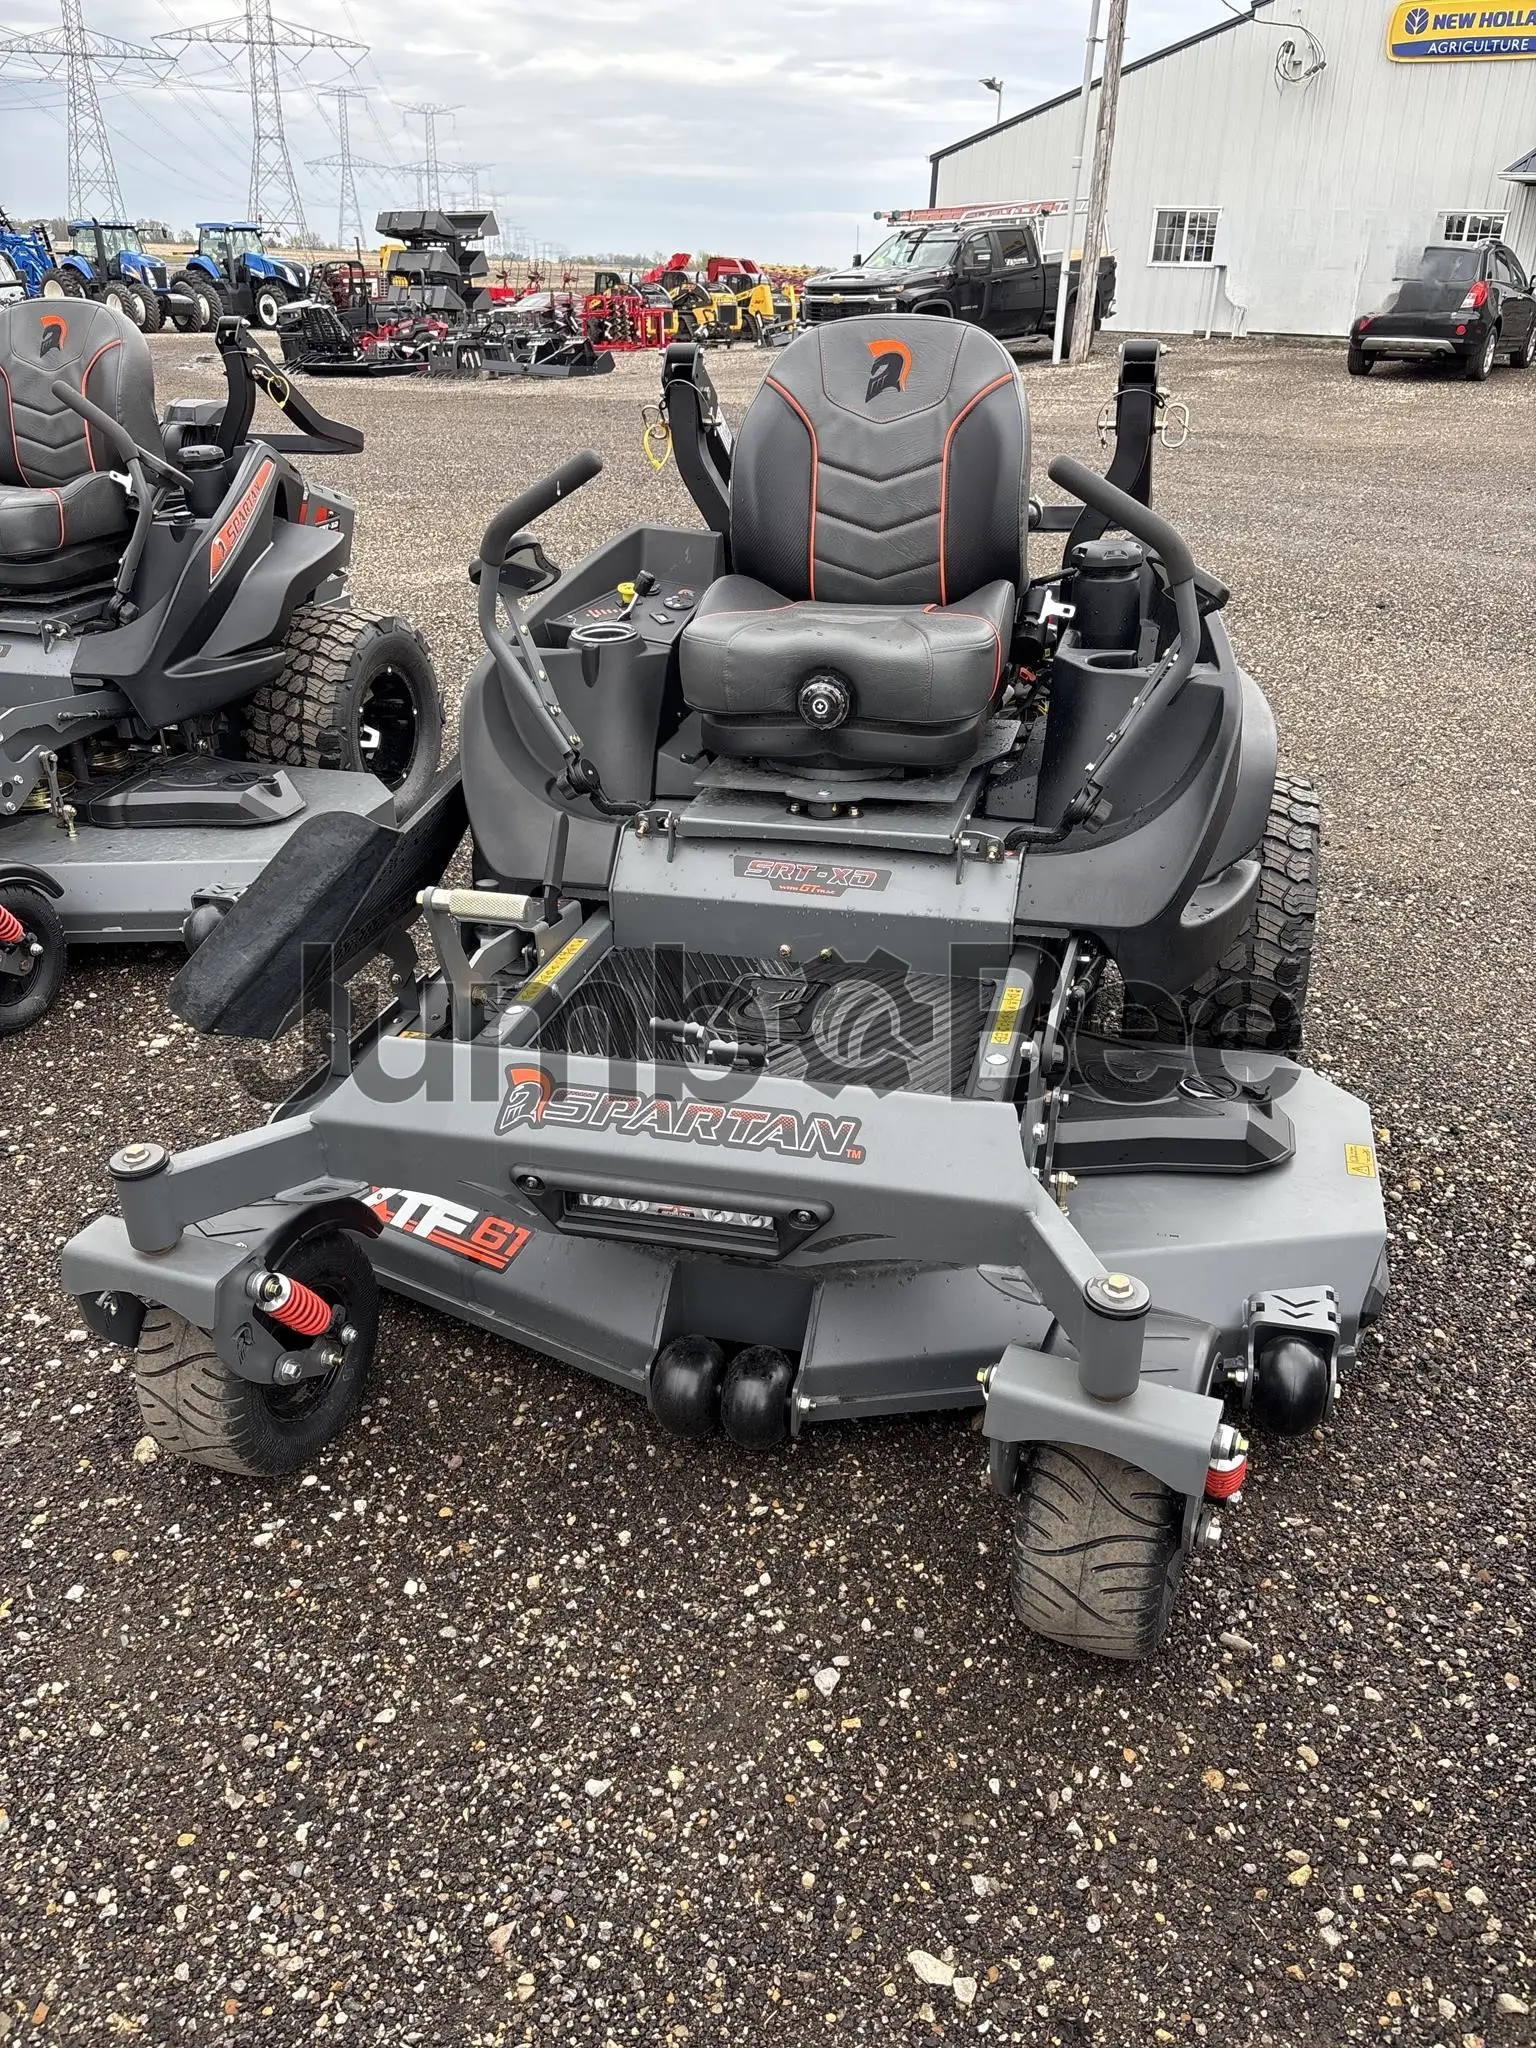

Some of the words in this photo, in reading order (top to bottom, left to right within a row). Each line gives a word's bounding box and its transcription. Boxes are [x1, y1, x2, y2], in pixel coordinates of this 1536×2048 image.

[1432, 13, 1476, 30] NEW
[1428, 38, 1530, 54] AGRICULTURE
[543, 1088, 853, 1156] SPARTAN
[470, 1216, 532, 1257] 61
